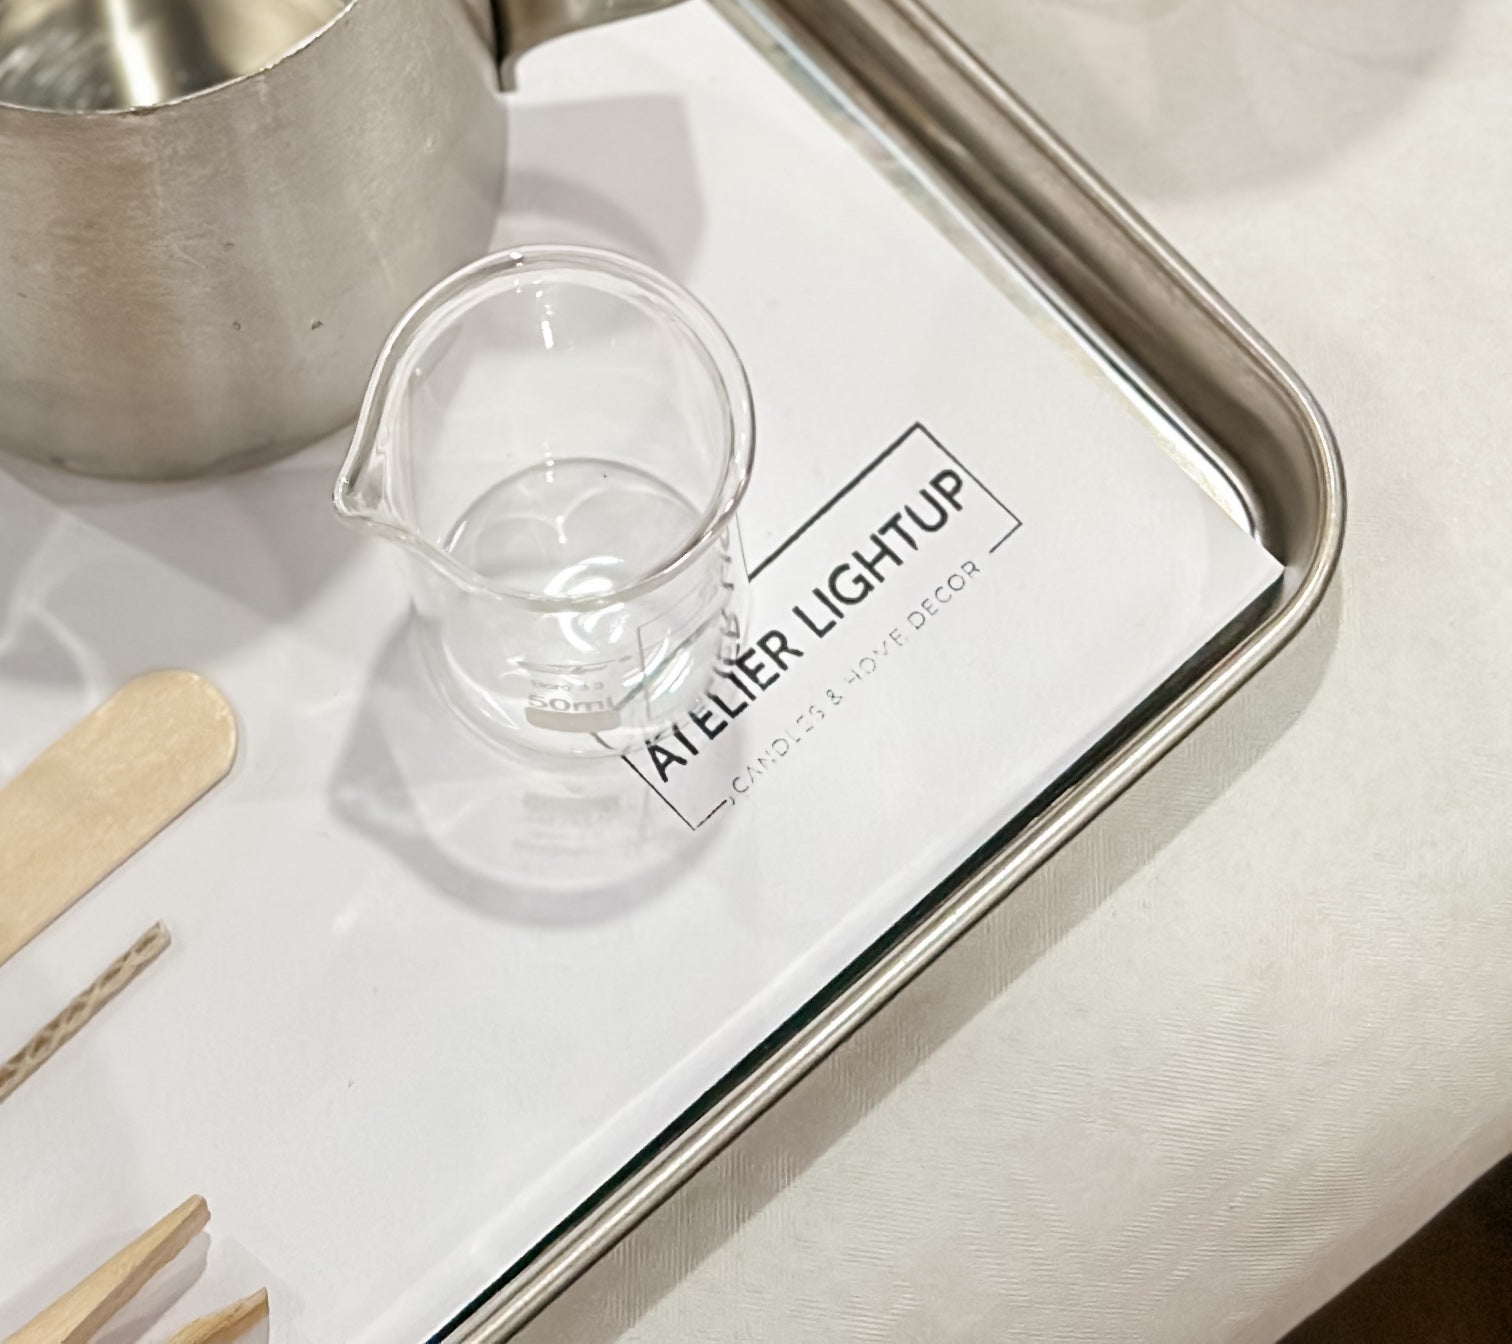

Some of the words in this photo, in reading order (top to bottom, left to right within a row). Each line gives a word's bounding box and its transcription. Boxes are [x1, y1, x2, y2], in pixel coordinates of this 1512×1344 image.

[644, 629, 804, 783] ATELIER
[791, 468, 964, 639] LIGHTUP
[825, 688, 843, 706] &
[906, 560, 982, 631] DECOR
